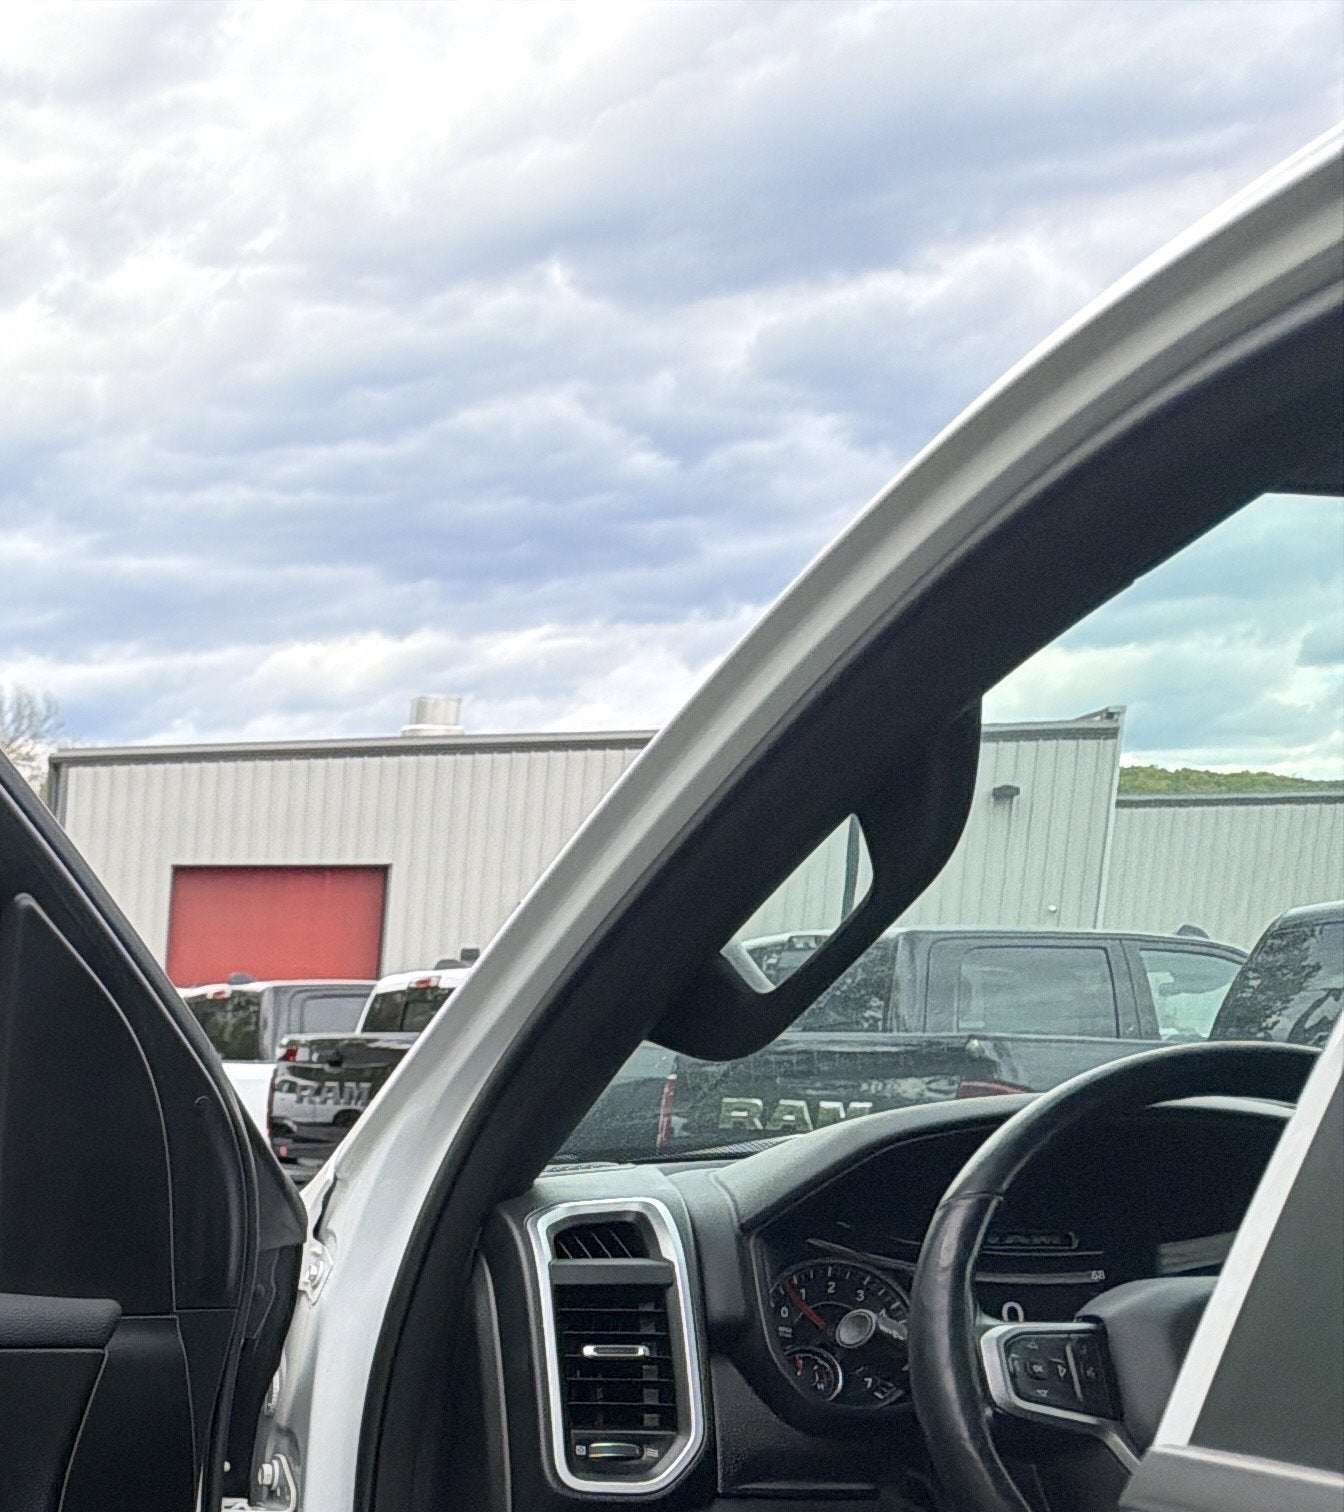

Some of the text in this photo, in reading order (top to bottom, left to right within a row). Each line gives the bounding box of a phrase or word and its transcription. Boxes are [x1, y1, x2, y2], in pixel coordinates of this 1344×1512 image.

[295, 1081, 372, 1106] RAM
[718, 1097, 873, 1131] RAM
[799, 1288, 806, 1300] 1
[827, 1281, 836, 1294] 2
[855, 1289, 865, 1302] 3
[780, 1306, 789, 1318] 0
